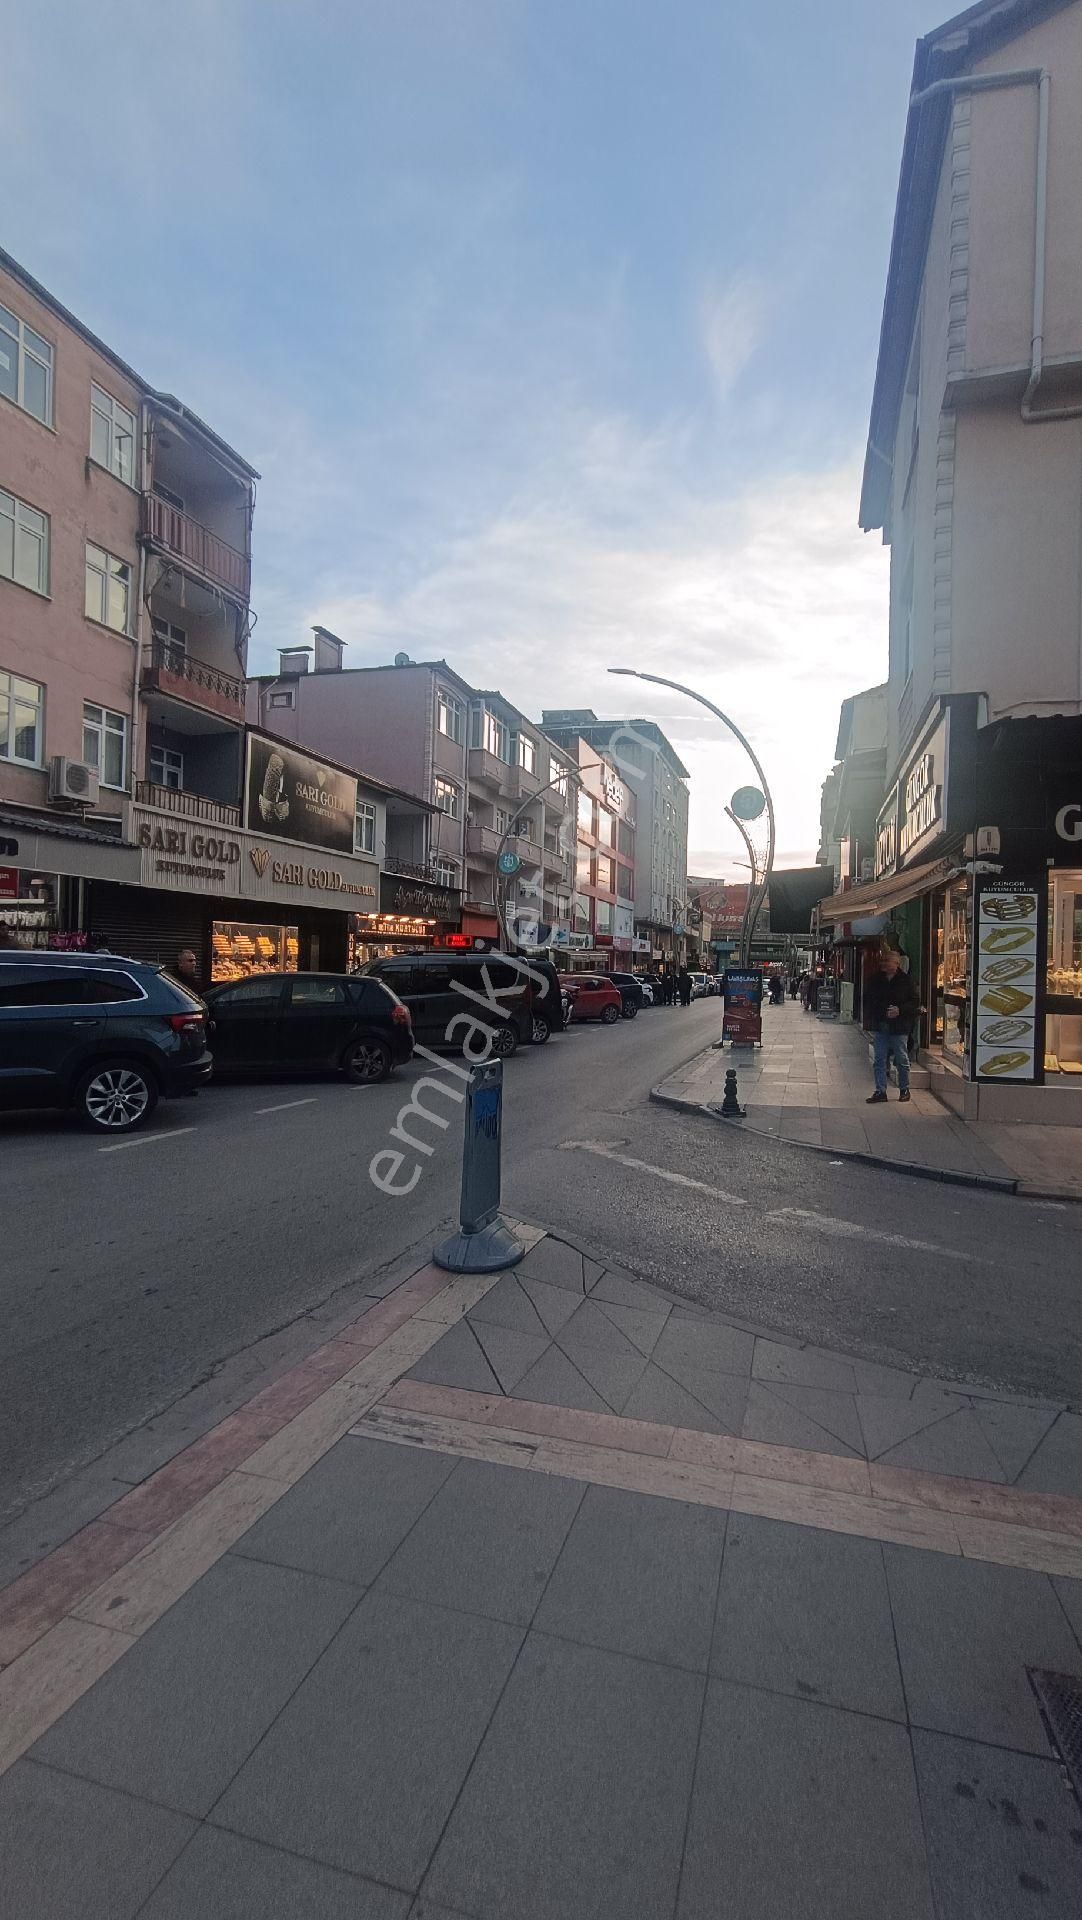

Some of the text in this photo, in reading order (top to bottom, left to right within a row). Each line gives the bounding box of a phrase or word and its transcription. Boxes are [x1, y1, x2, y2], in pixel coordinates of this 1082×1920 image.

[295, 781, 346, 812] SARI GOLD
[138, 822, 241, 864] SARI GOLD
[272, 861, 304, 886] SARI
[307, 868, 342, 890] GOLD
